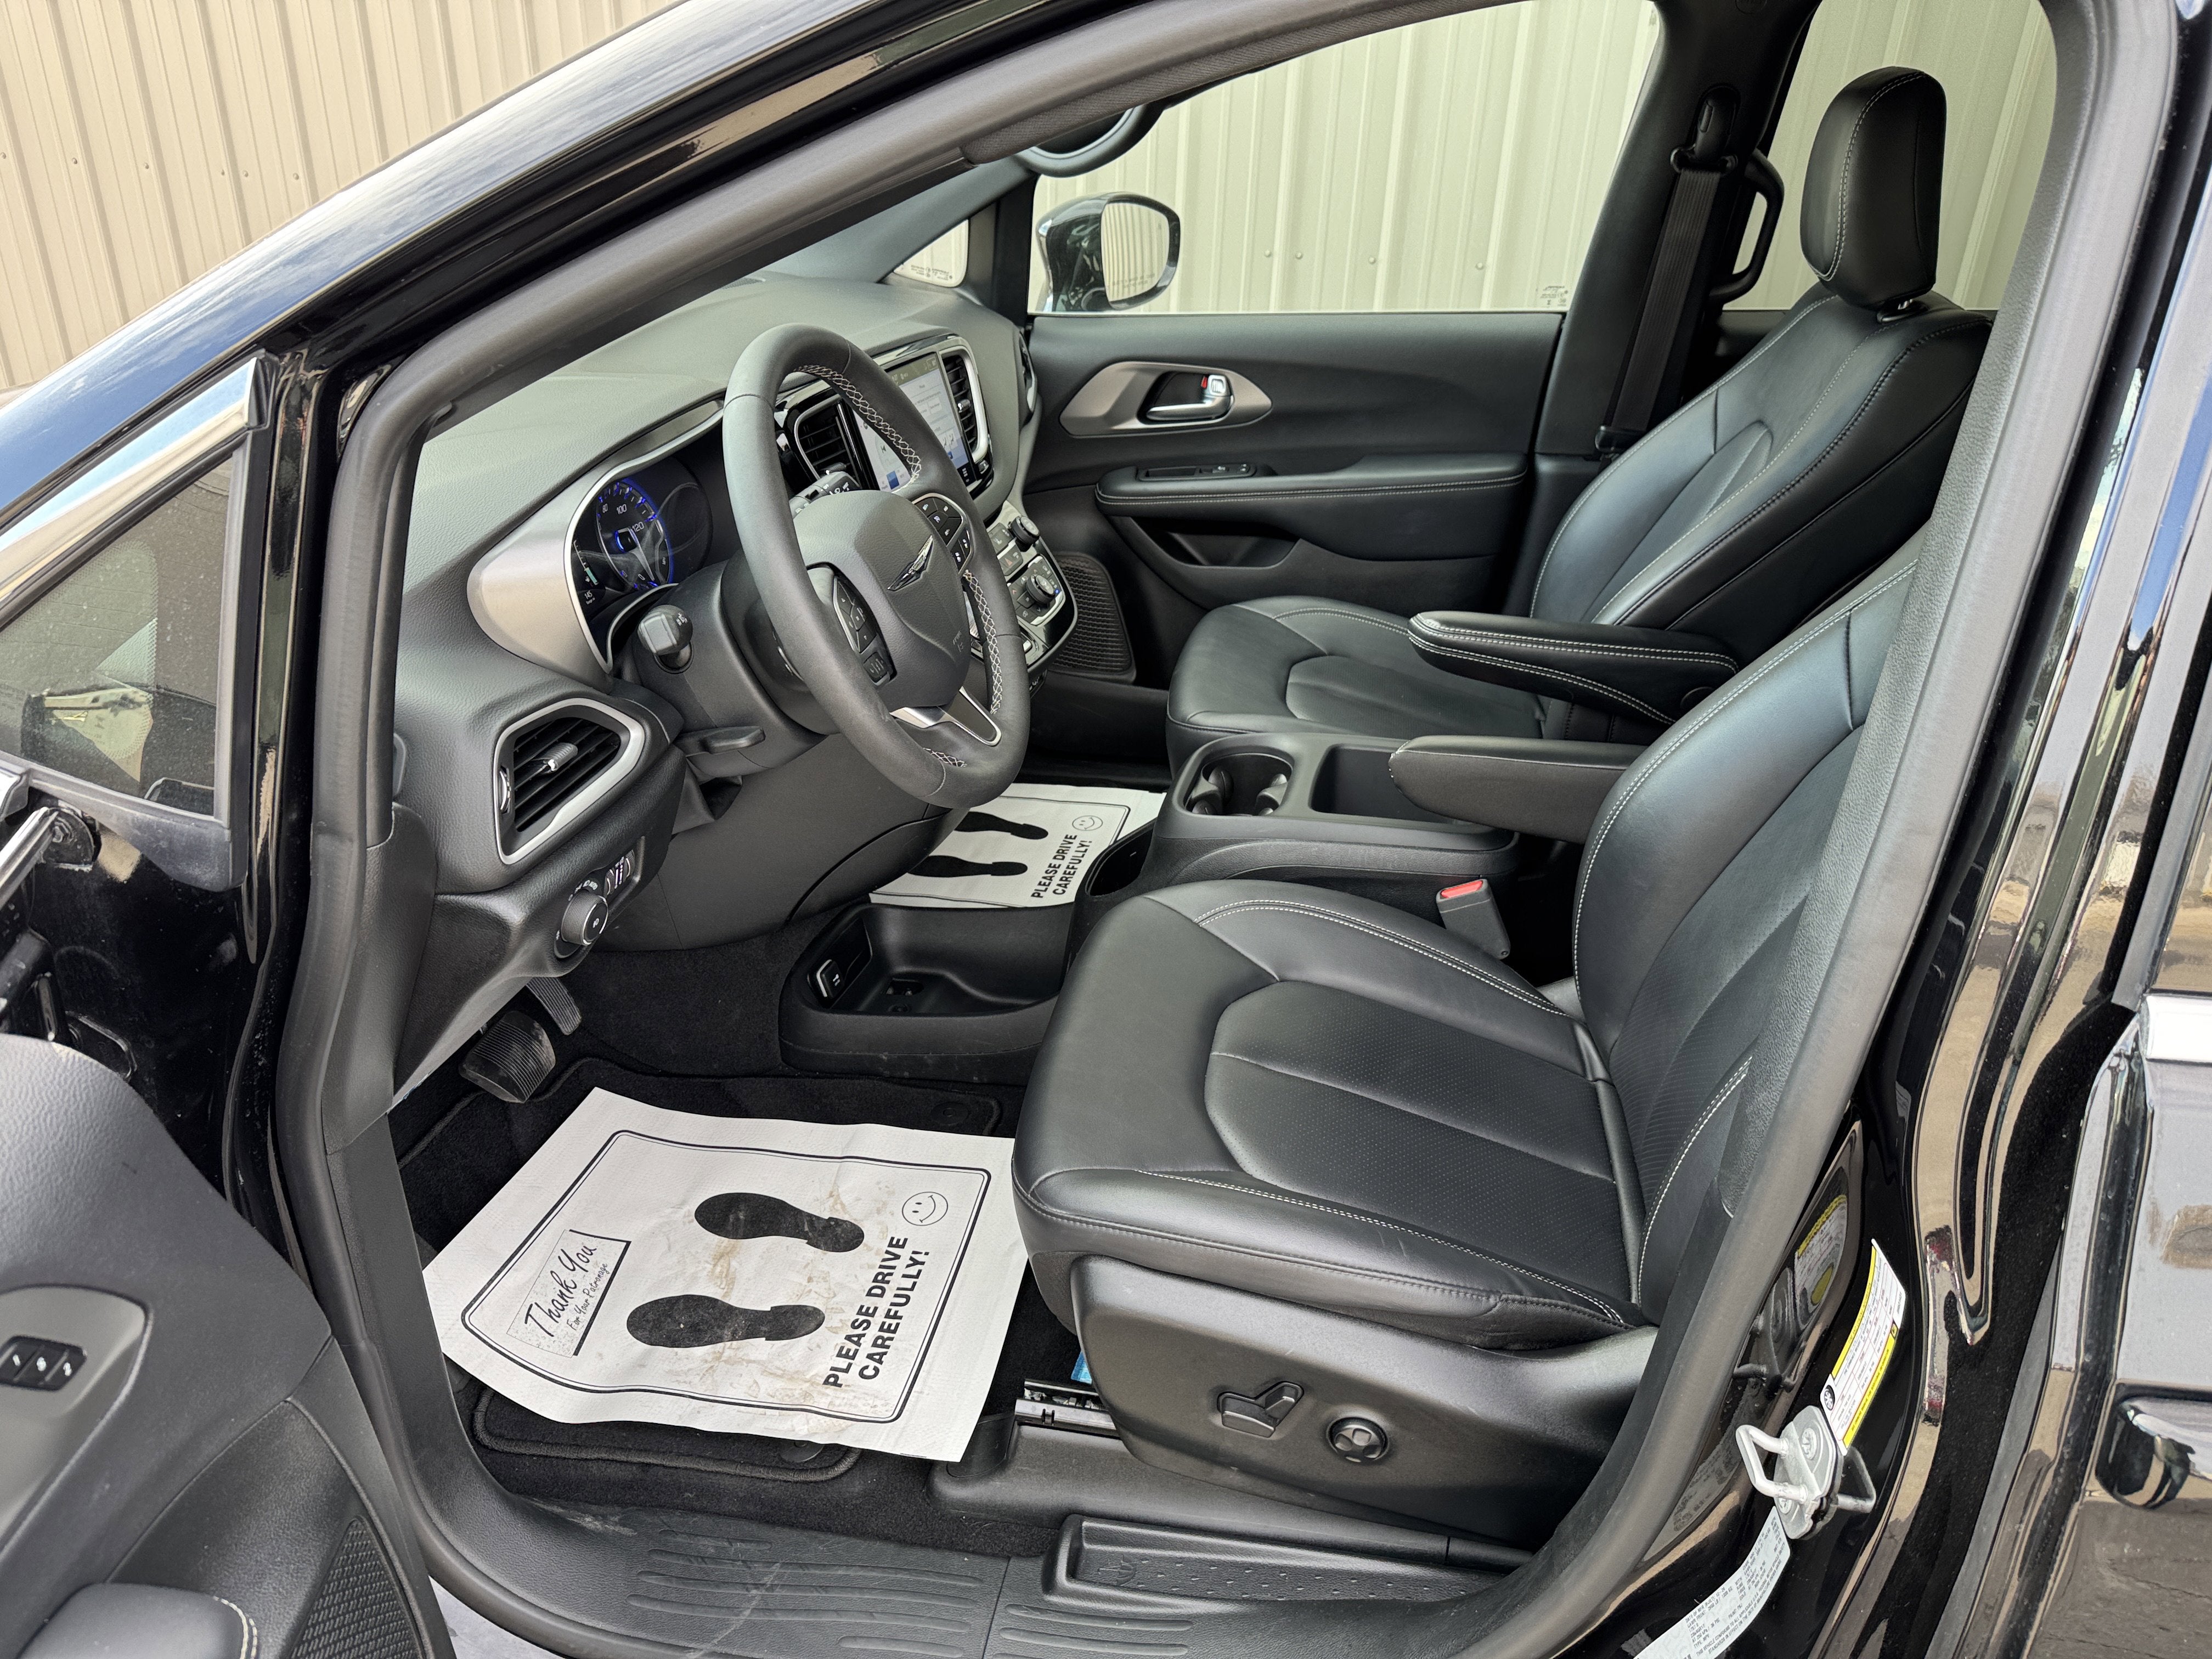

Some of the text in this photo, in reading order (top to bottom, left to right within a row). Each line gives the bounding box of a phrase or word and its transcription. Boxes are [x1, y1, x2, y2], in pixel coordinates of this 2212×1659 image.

[616, 504, 627, 515] 100
[631, 521, 645, 532] 120
[584, 590, 592, 599] 145
[1030, 834, 1077, 898] PLEASE DRIVE
[1052, 840, 1092, 895] CAREFULLY!
[524, 1245, 597, 1338] Thank You
[567, 1263, 610, 1331] For Your Patronage
[822, 1236, 908, 1388] PLEASE DRIVE
[858, 1250, 930, 1380] CAREFULLY!
